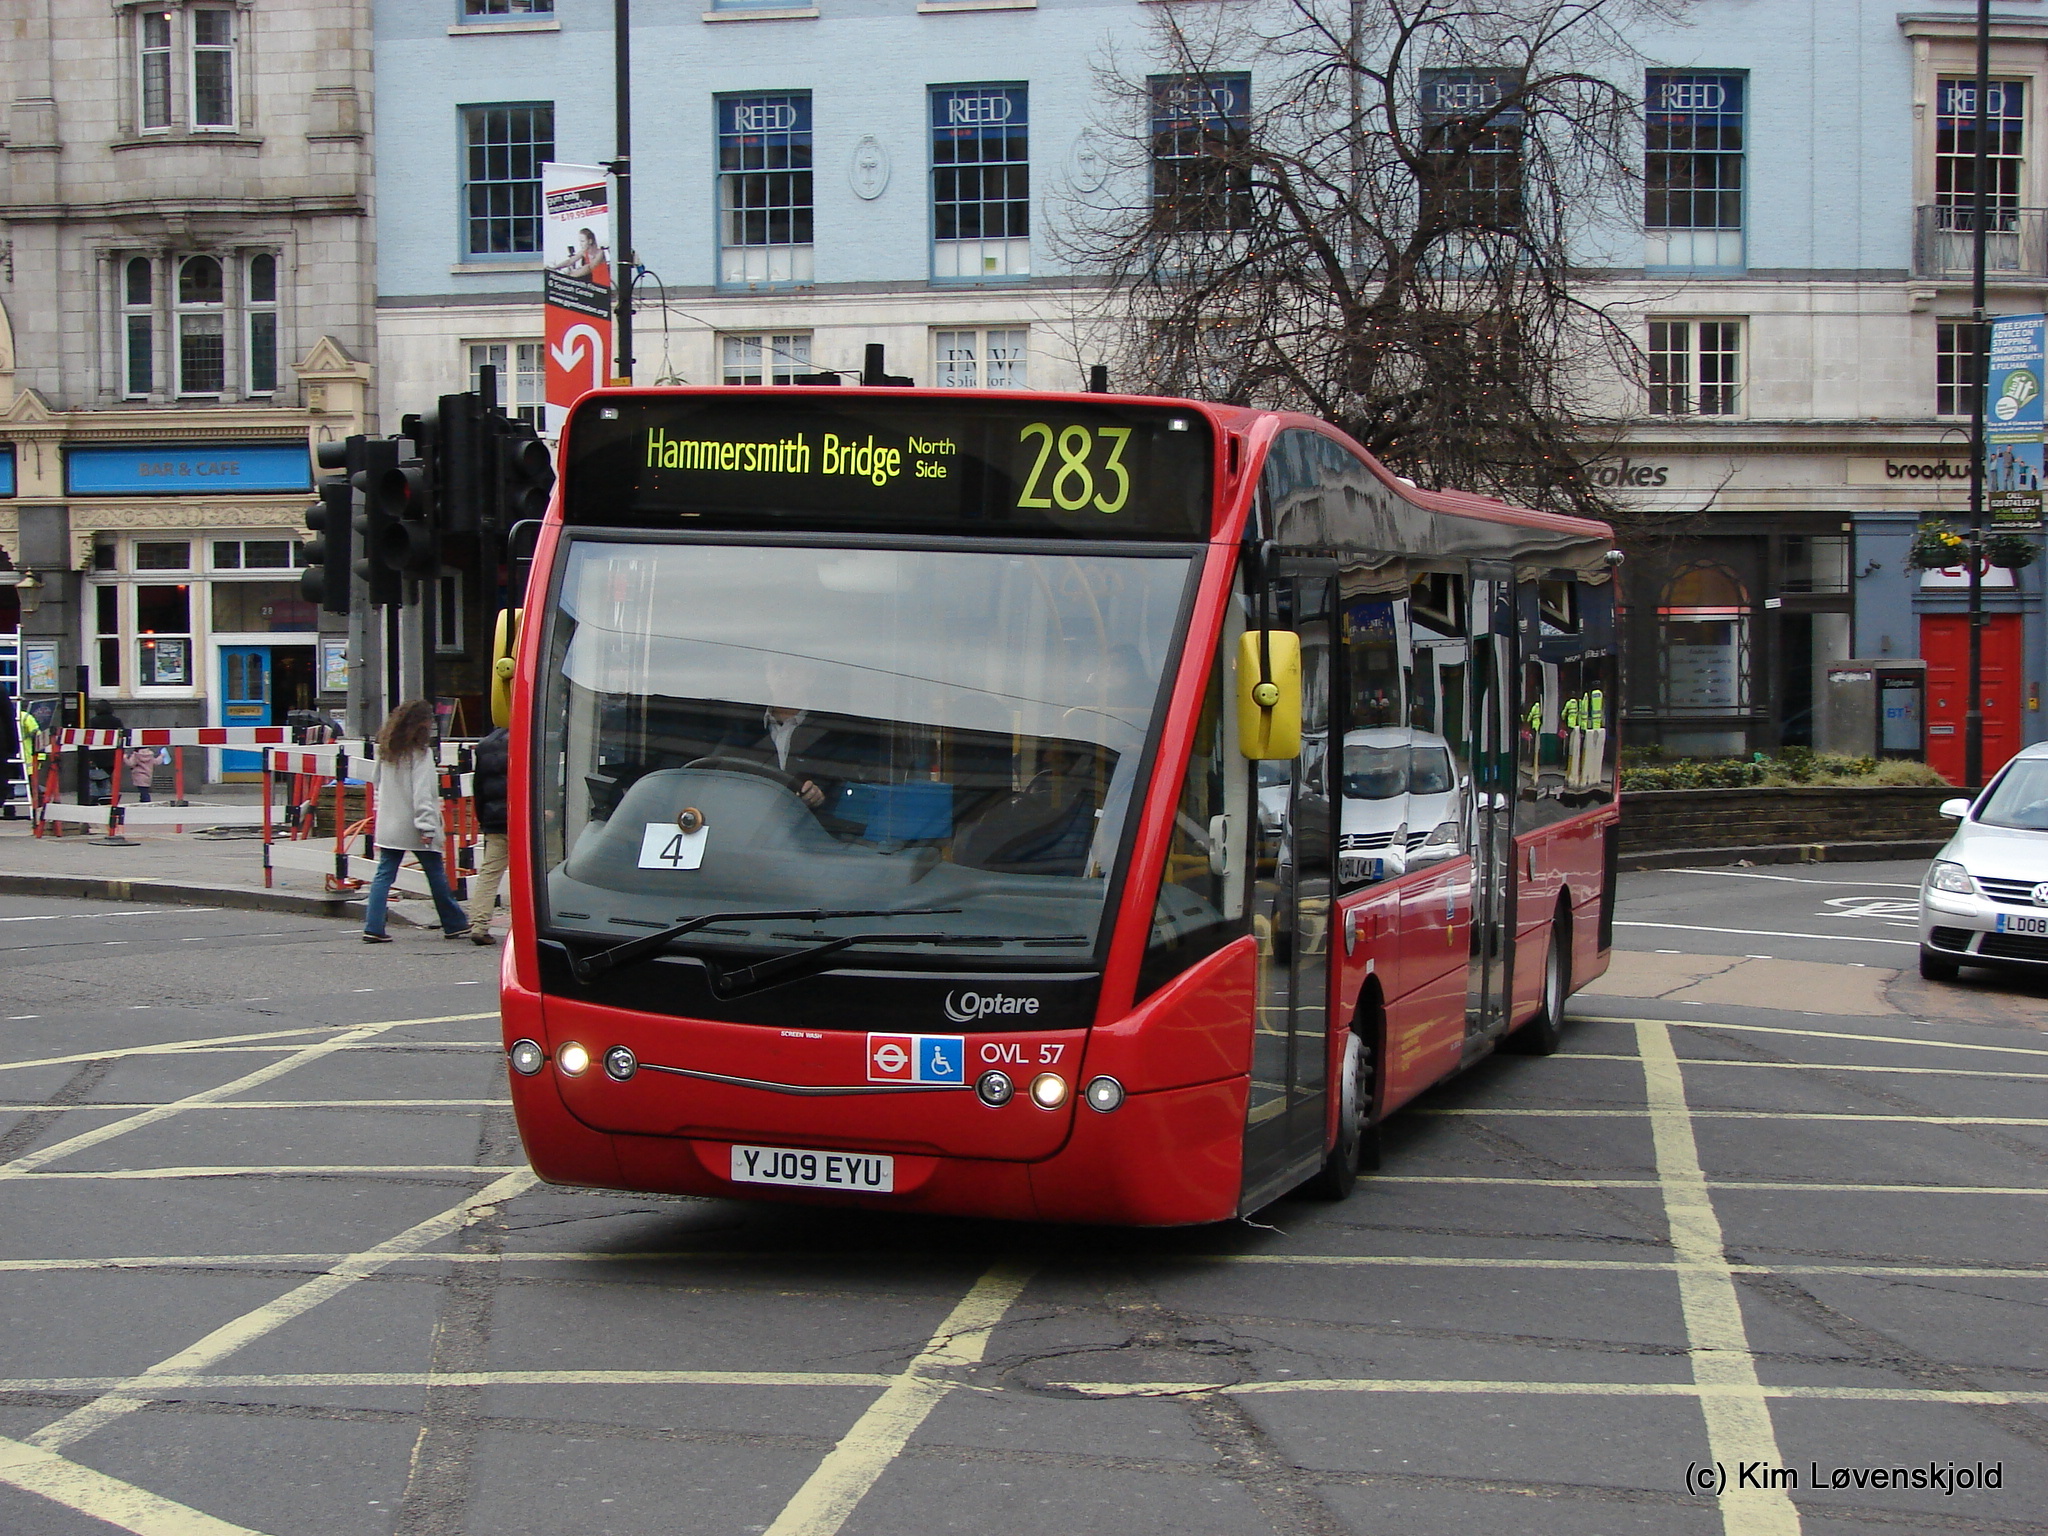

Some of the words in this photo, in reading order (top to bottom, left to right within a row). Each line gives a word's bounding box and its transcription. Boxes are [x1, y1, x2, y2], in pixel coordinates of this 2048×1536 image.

[1437, 83, 1502, 109] REED
[1661, 84, 1726, 109] REED
[735, 105, 797, 131] REED
[949, 97, 1012, 123] REED
[647, 427, 810, 473] Hammersmith
[822, 433, 900, 486] Bridge
[908, 436, 956, 455] North
[139, 462, 174, 476] BAR
[178, 462, 191, 476] &
[196, 461, 240, 476] CAFE
[915, 460, 947, 478] Side
[1016, 422, 1132, 514] 283
[1886, 459, 1987, 478] broadw
[262, 607, 273, 615] 28
[1887, 708, 1904, 718] BT
[660, 834, 683, 867] 4
[2007, 917, 2047, 933] LD08
[960, 991, 1039, 1018] Optare
[980, 1043, 1029, 1064] OVL
[1039, 1044, 1065, 1065] 57
[743, 1150, 817, 1181] YJ09
[826, 1156, 881, 1186] EYU
